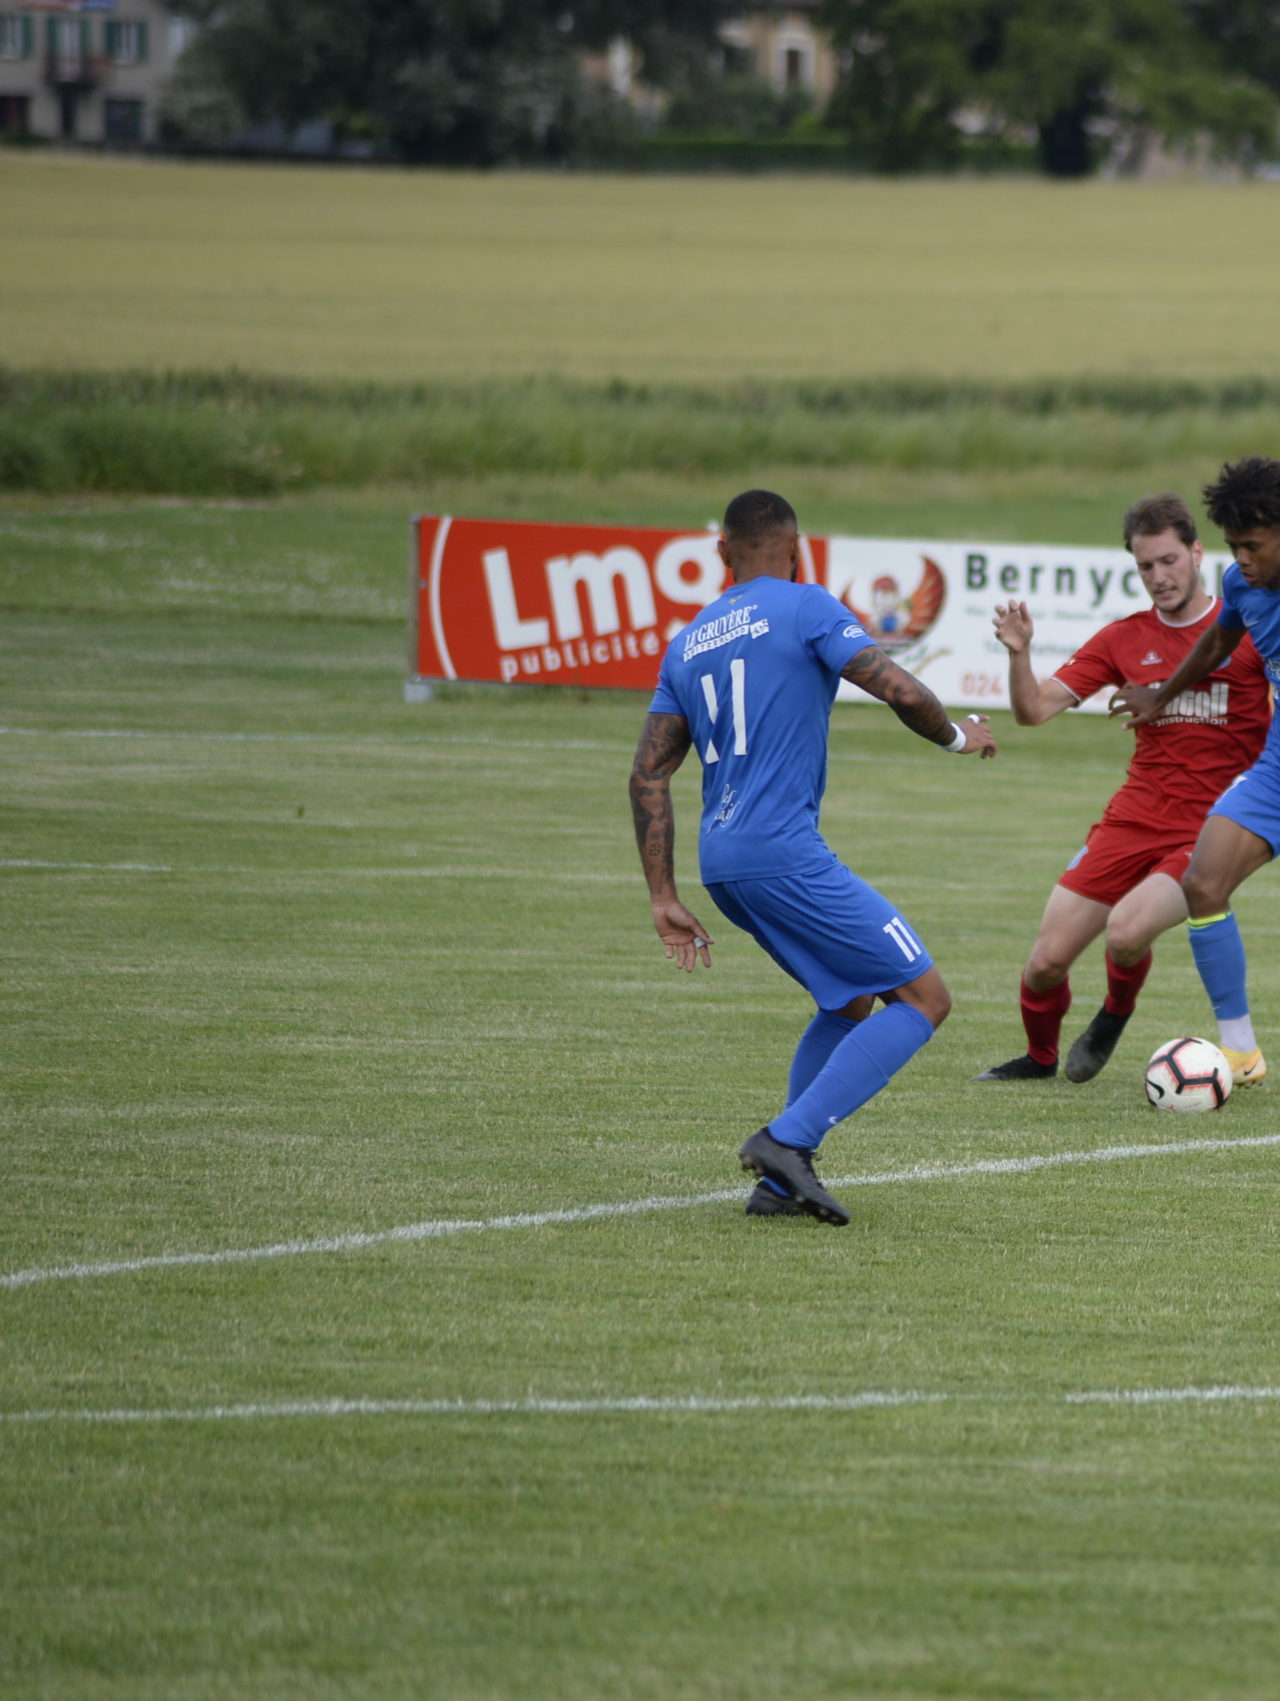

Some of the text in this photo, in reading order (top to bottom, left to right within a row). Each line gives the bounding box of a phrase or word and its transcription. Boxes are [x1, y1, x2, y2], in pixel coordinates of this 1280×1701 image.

[501, 631, 660, 684] publicité
[961, 673, 1003, 696] 024
[882, 916, 922, 962] 11
